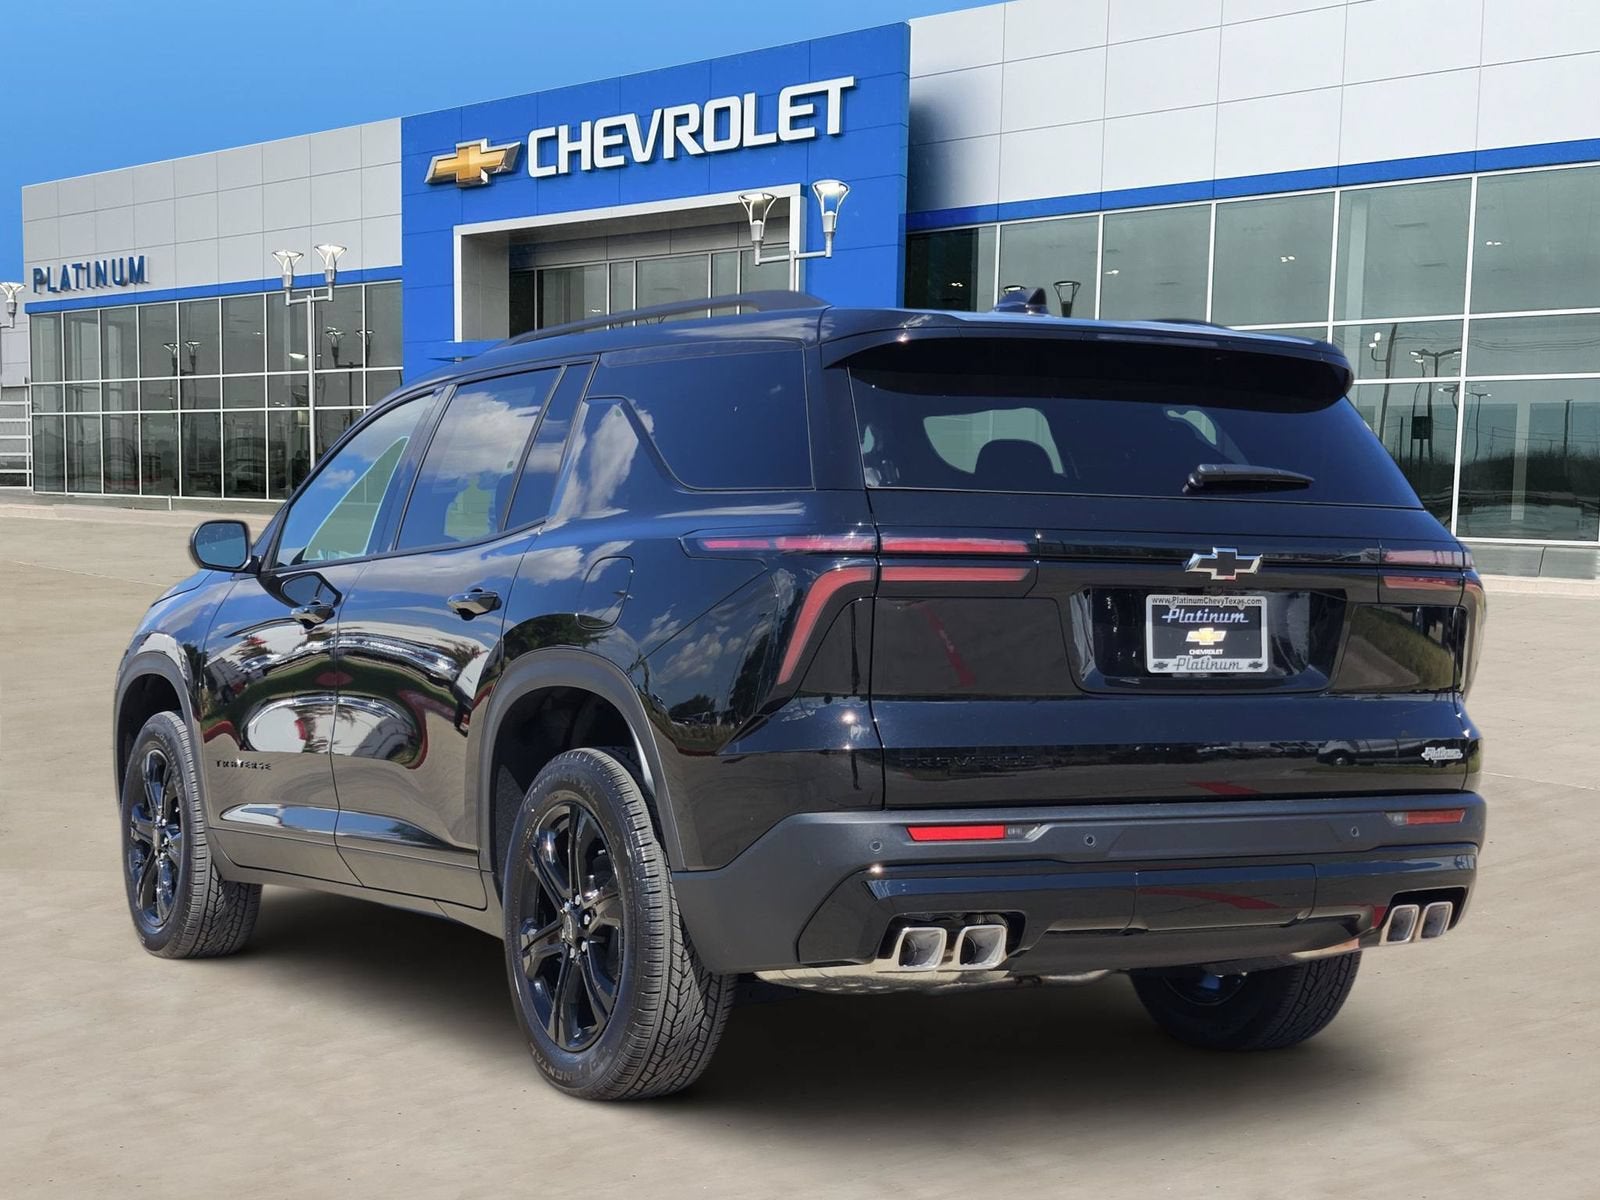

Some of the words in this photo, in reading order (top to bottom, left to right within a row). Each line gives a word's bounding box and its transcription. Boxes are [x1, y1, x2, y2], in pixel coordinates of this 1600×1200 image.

[527, 75, 856, 179] CHEVROLET
[32, 255, 146, 295] PLATINUM
[1161, 608, 1249, 623] Platinum
[1188, 648, 1224, 656] CHEVROLET
[1172, 656, 1244, 671] Platinum
